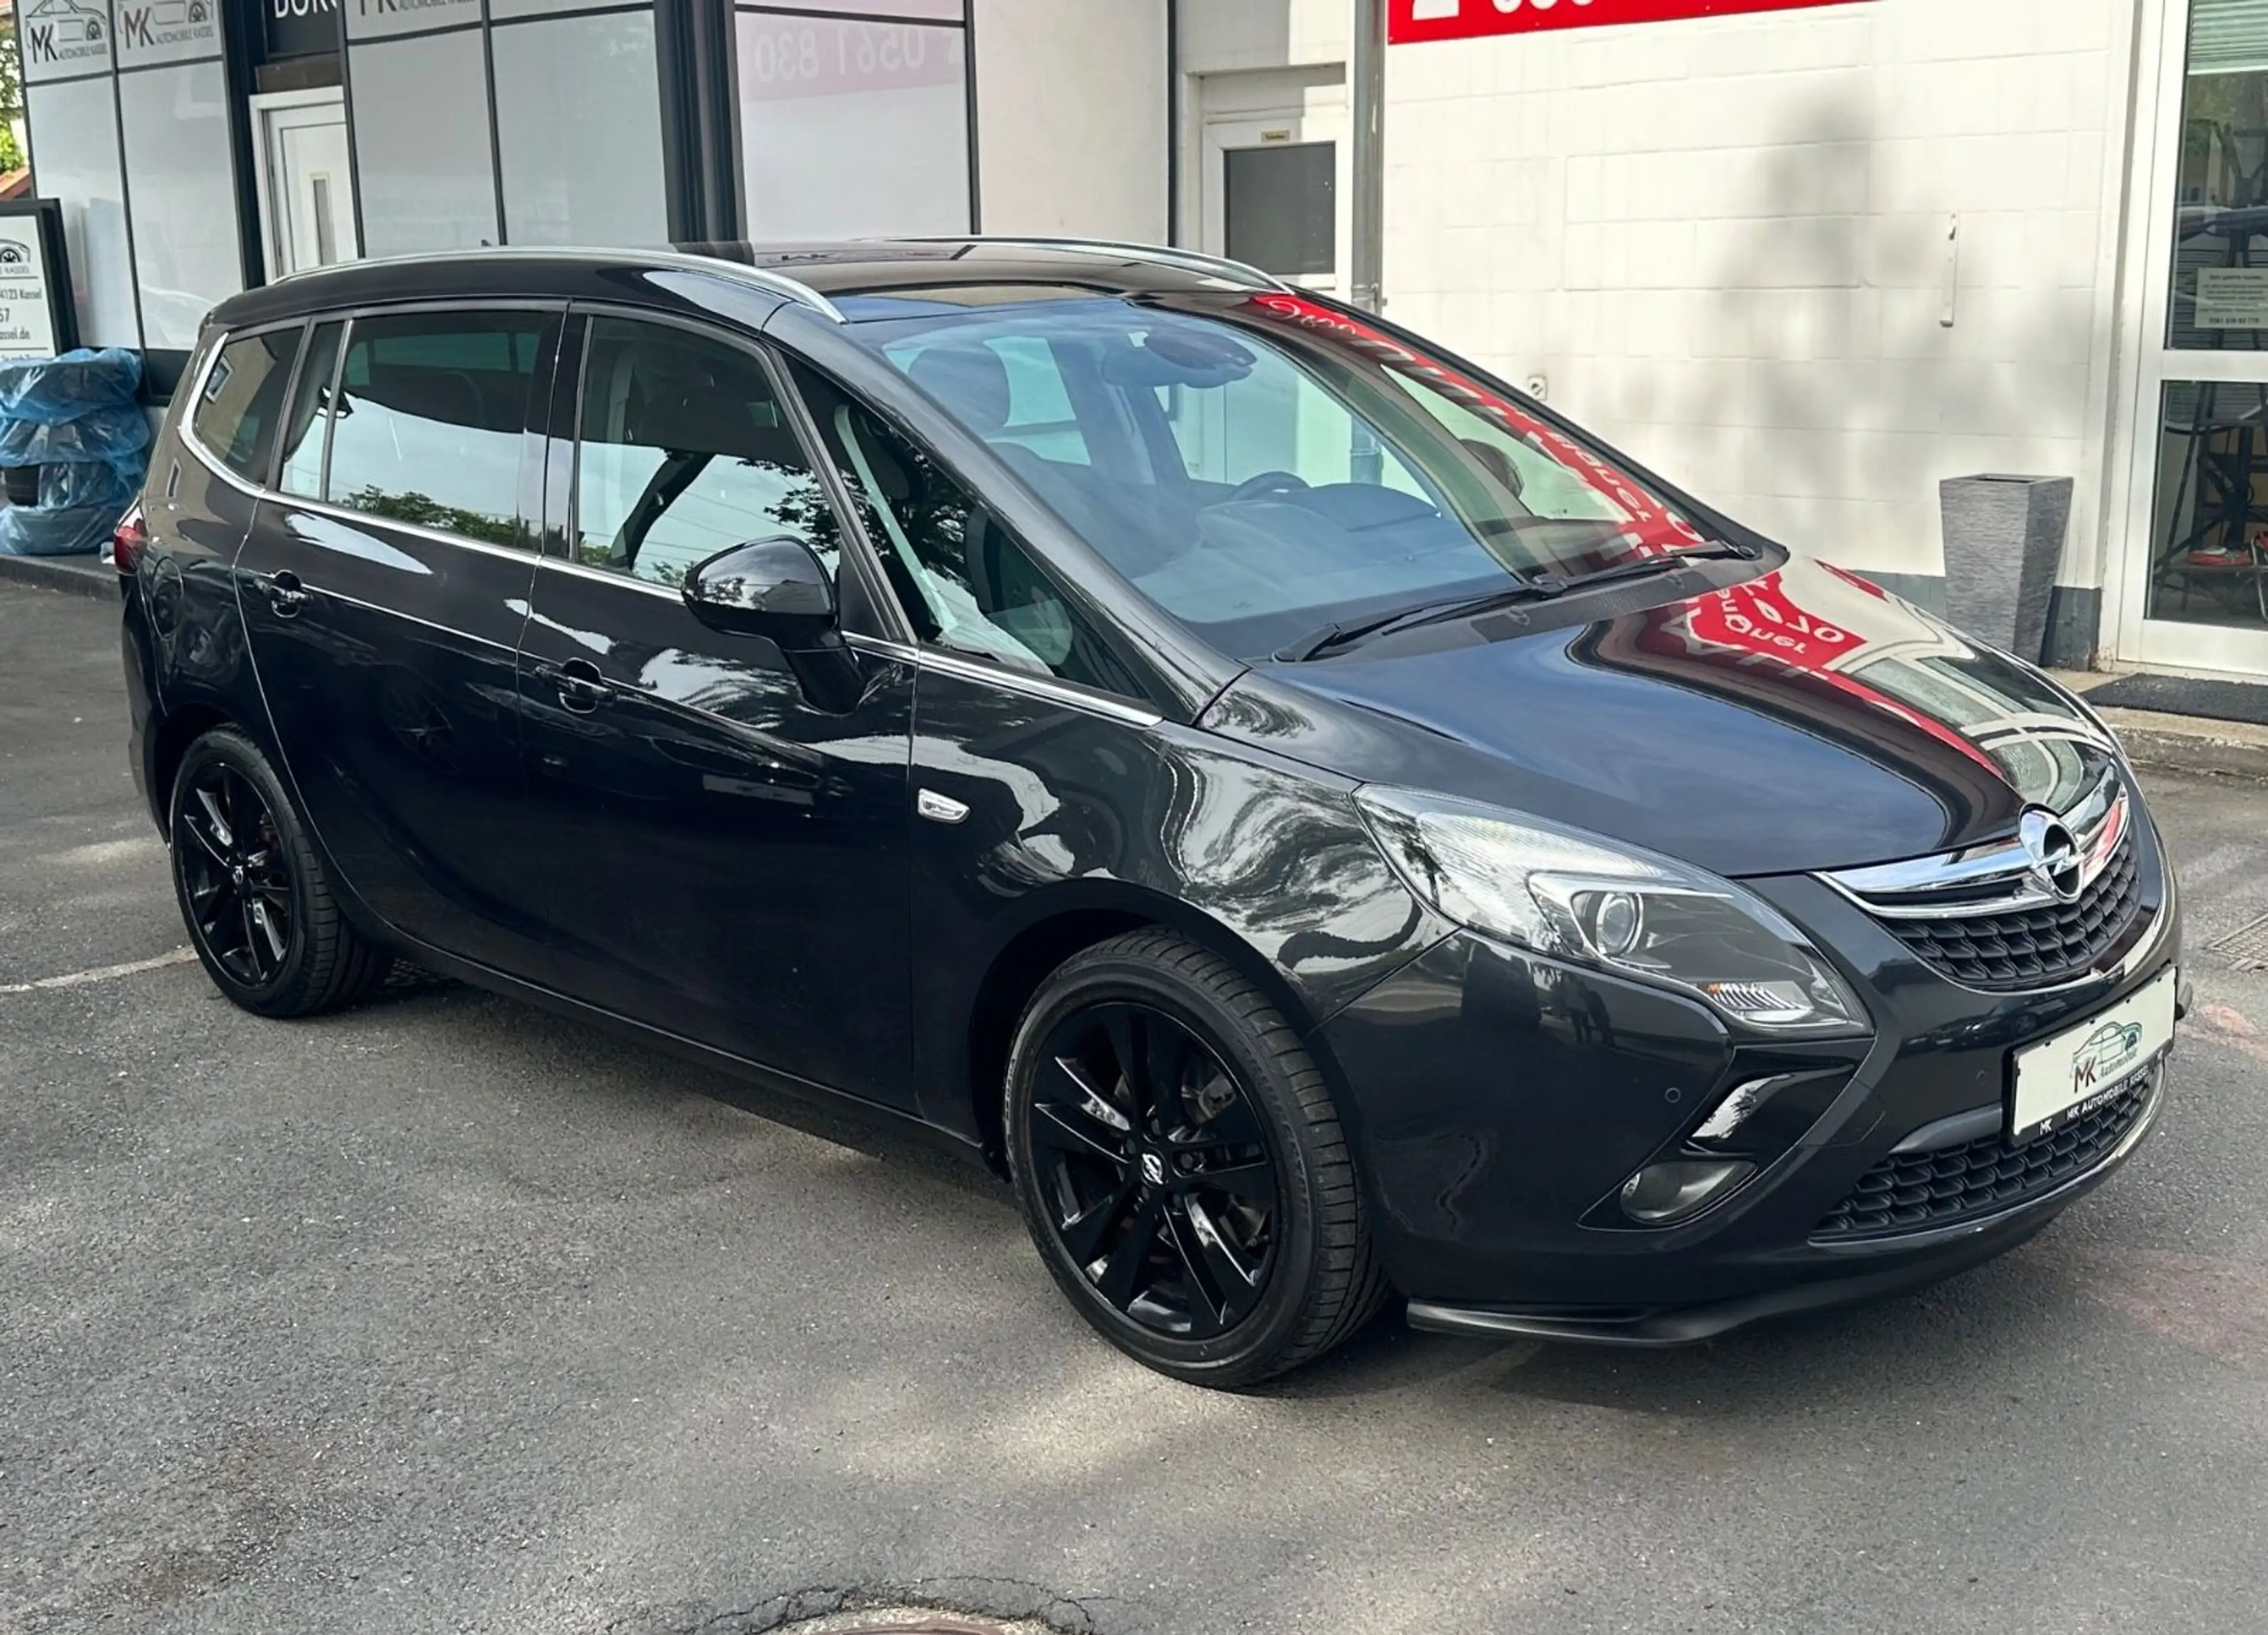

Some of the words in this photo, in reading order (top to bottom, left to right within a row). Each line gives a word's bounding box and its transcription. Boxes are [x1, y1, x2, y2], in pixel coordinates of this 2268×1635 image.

[30, 23, 58, 64] MK
[125, 6, 155, 50] MK
[2074, 1056, 2096, 1094] MK
[2081, 1079, 2129, 1114] AUTOMOBILE
[2039, 1118, 2054, 1135] MK
